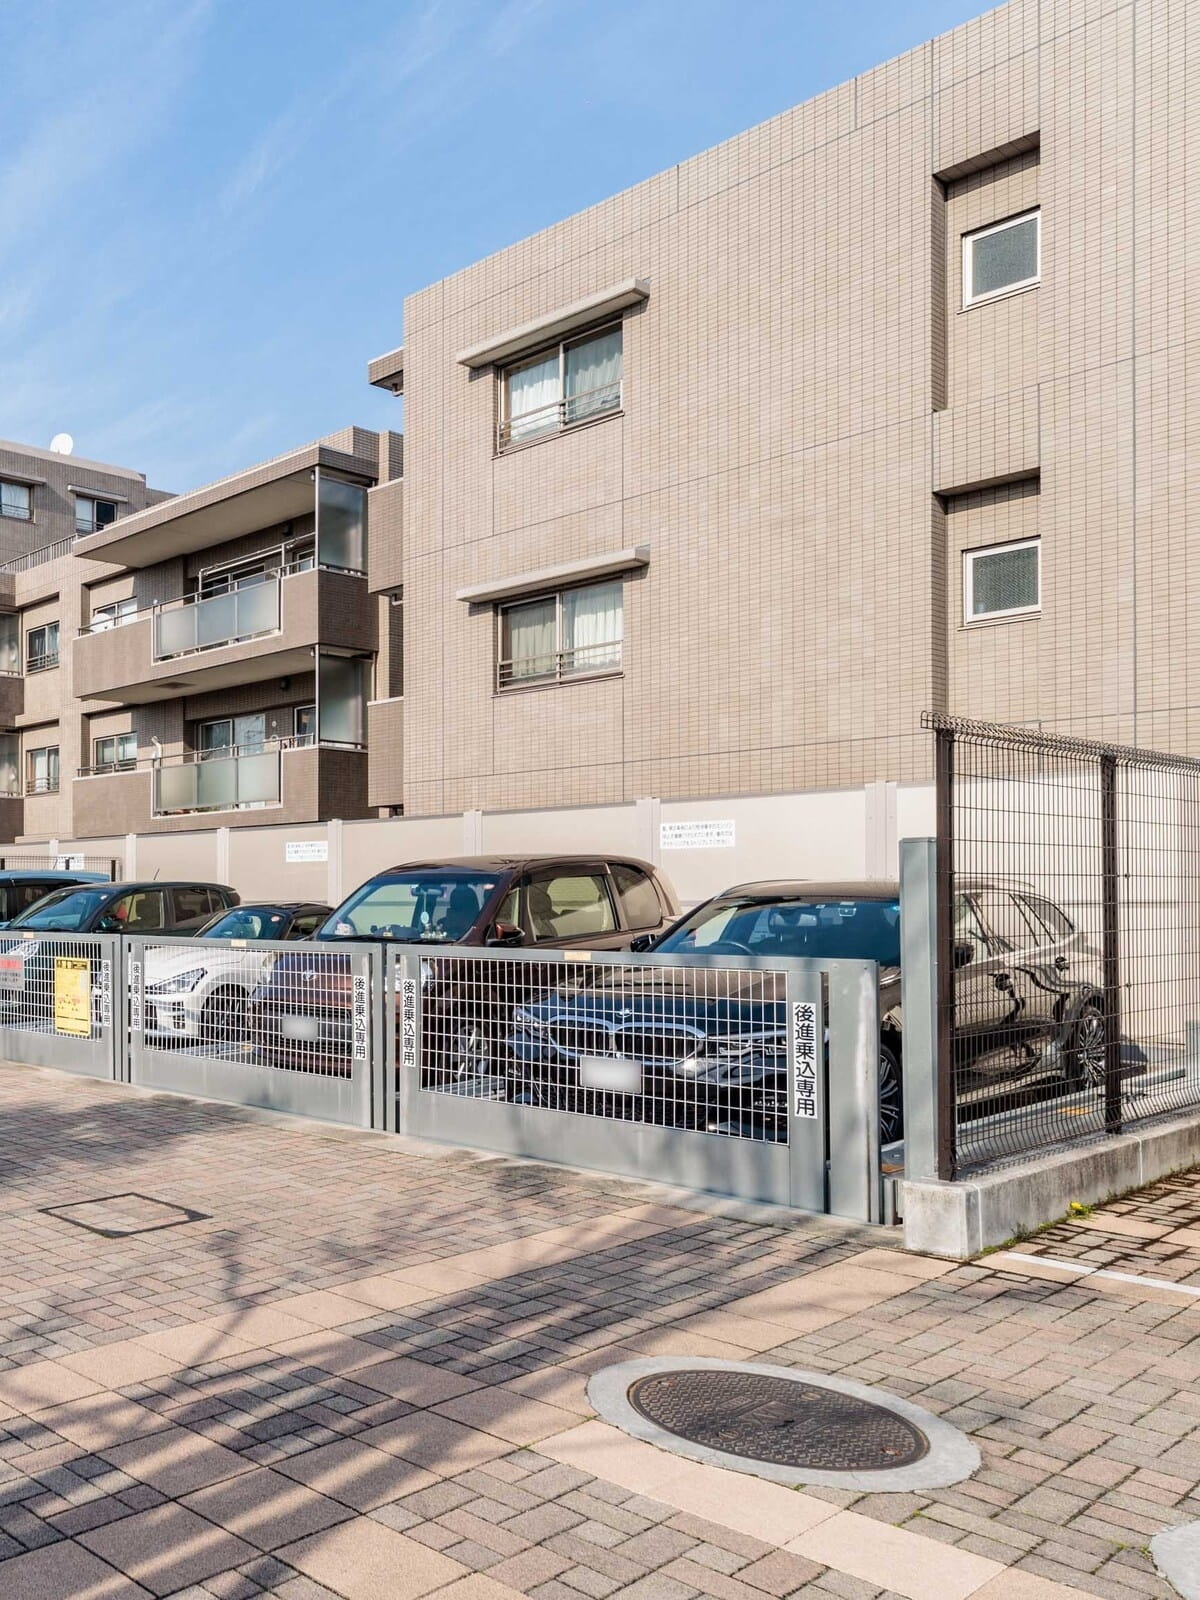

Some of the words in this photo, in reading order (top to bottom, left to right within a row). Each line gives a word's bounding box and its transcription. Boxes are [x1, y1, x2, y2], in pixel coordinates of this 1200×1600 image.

[354, 977, 366, 1059] 後進乗込専用
[403, 980, 415, 1066] 後進乗込専用
[794, 1004, 815, 1117] 後進乗込専用
